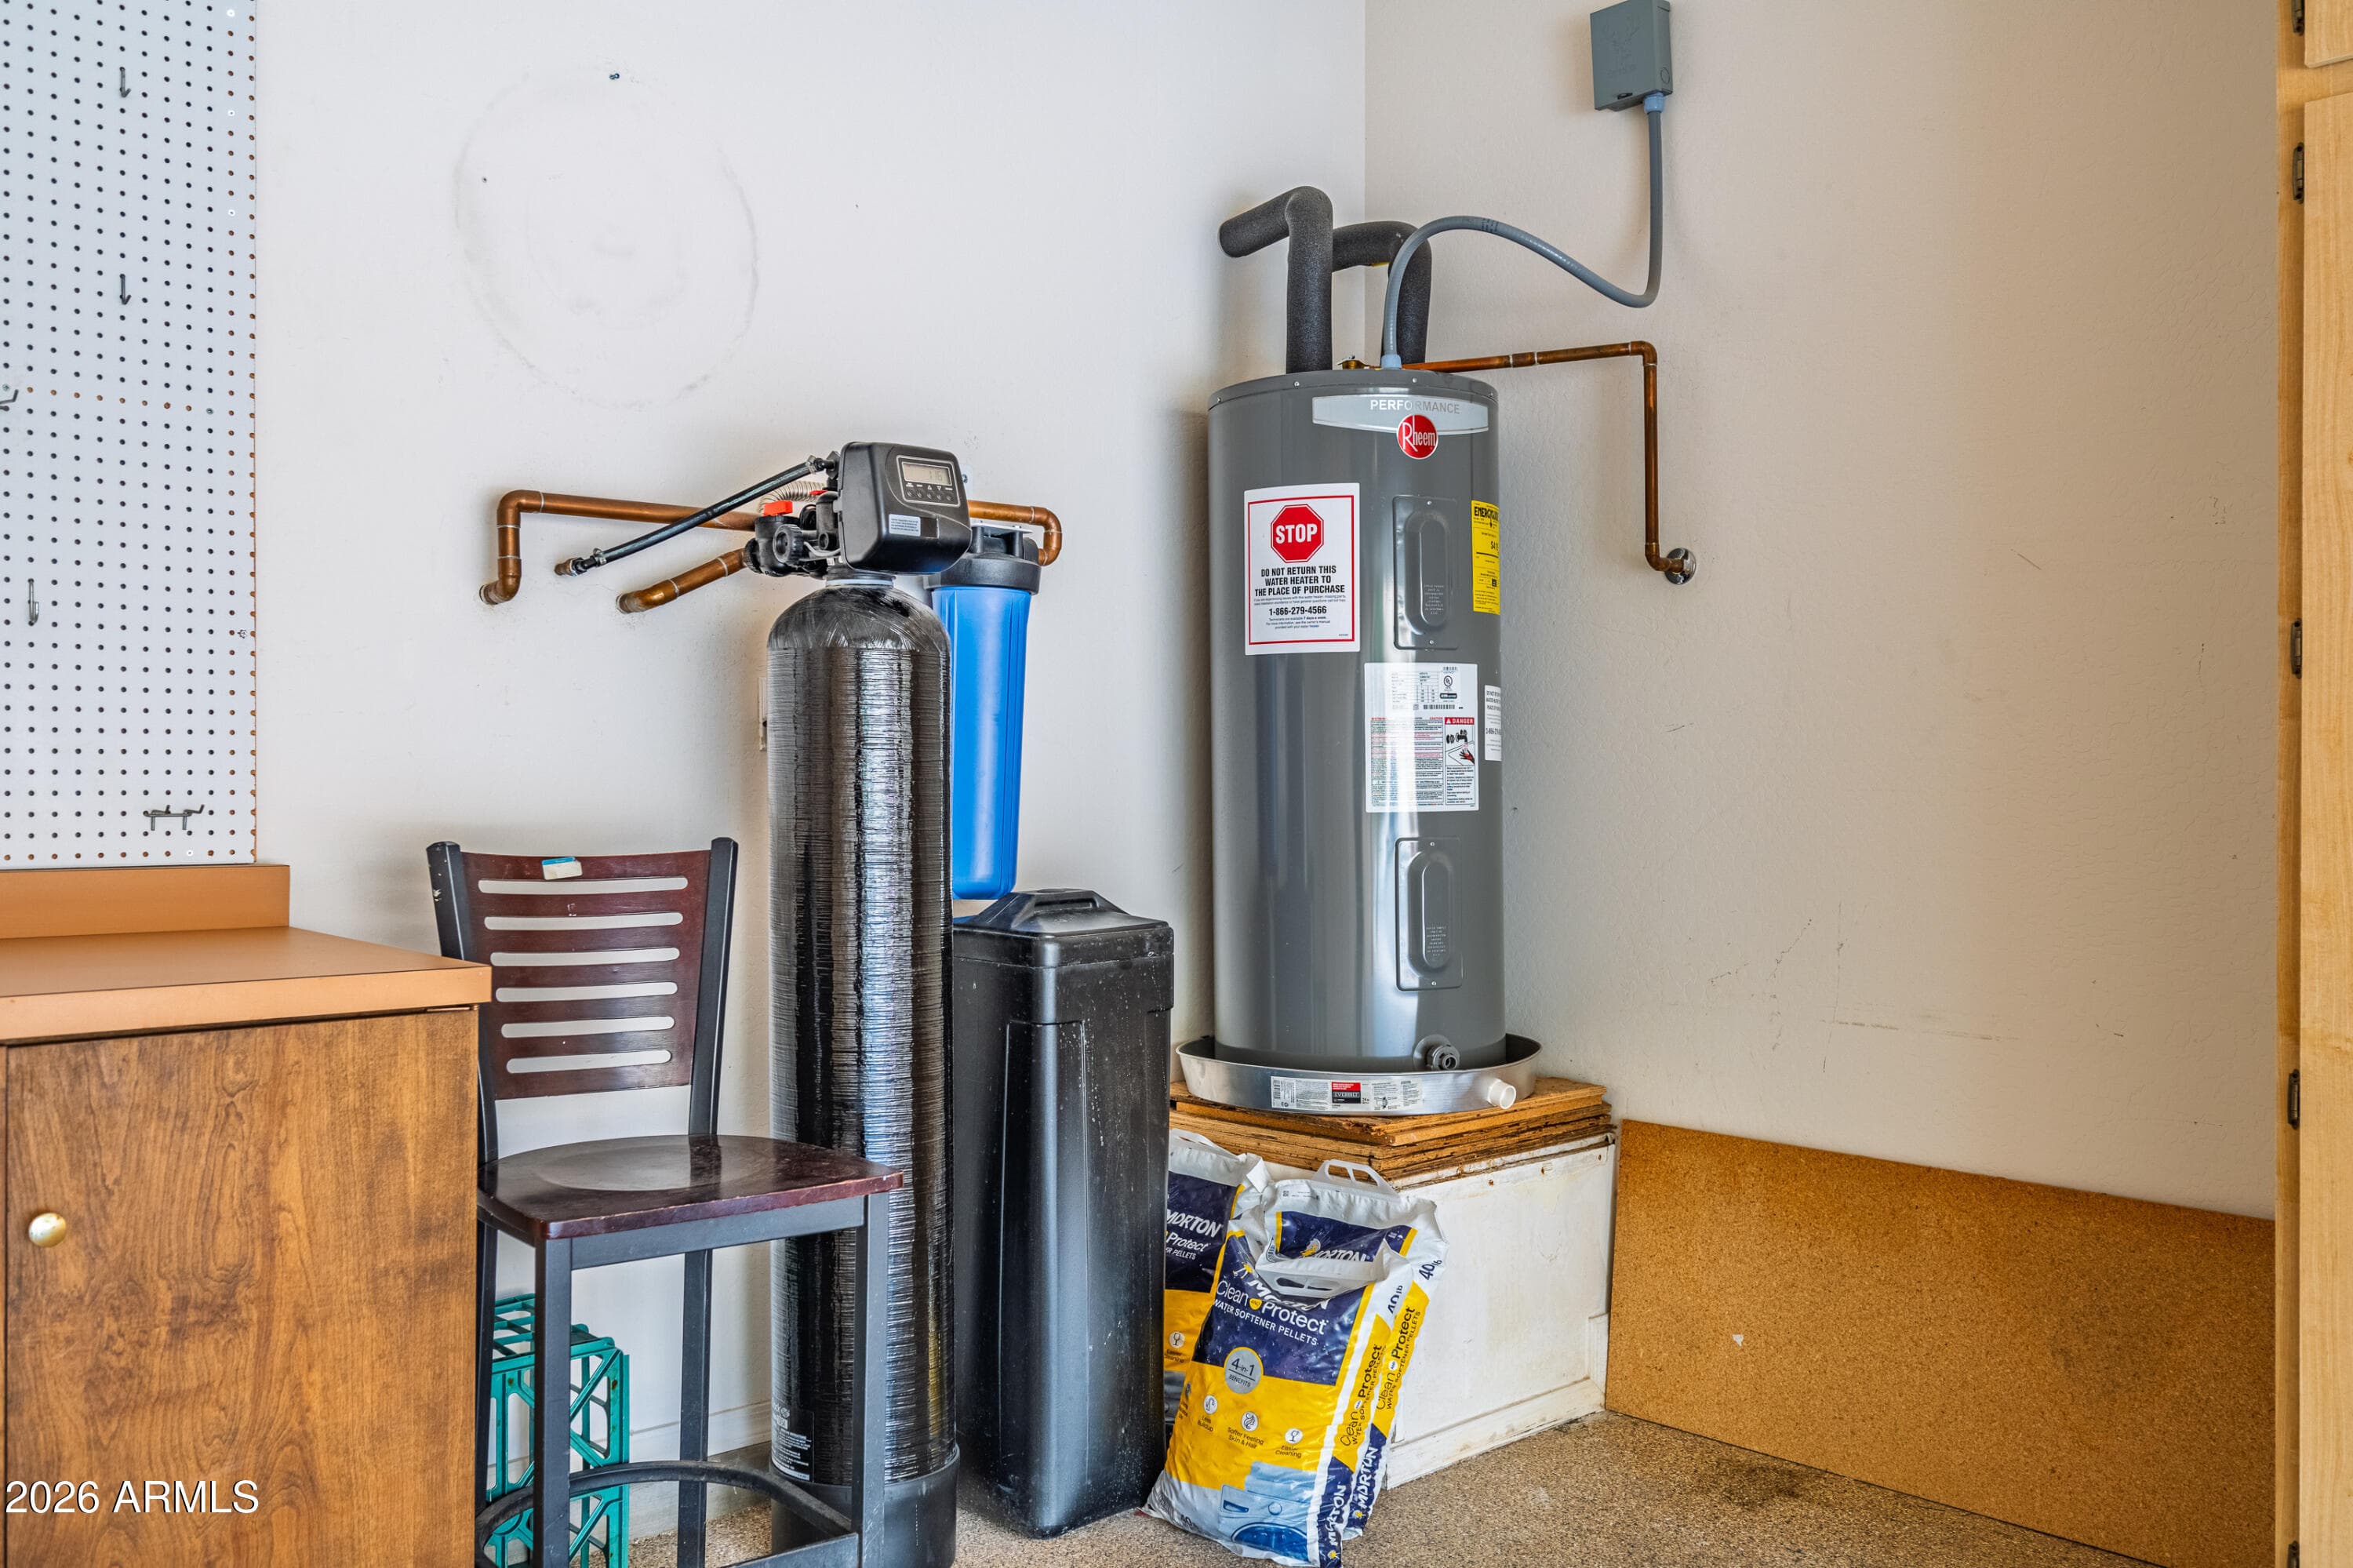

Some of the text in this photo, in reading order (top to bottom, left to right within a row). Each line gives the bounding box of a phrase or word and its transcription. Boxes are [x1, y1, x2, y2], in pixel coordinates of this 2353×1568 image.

[1370, 399, 1460, 414] PERFORMANCE
[1402, 415, 1436, 452] Rheem
[1275, 523, 1318, 544] STOP
[1261, 566, 1337, 577] DO NOT RETURN THIS
[1265, 575, 1331, 586] WATER HEATER TO
[1268, 587, 1289, 595] PLACE
[1292, 586, 1301, 595] OF
[1304, 585, 1345, 594] PURCHASE
[1269, 606, 1327, 616] 1-866-279-4566
[1166, 1231, 1209, 1252] Protect
[1172, 1250, 1197, 1260] PELLETS
[1217, 1280, 1249, 1306] Clean
[1261, 1301, 1328, 1334] Protect
[1213, 1299, 1318, 1345] WATER SOFTENER PELLETS
[1377, 1373, 1395, 1410] Clean
[1391, 1307, 1415, 1359] Protect
[1387, 1311, 1421, 1410] WATER SOFTENER PELLETS
[1228, 1374, 1251, 1388] BENEFITS
[1340, 1411, 1359, 1446] Clean
[1358, 1344, 1382, 1398] Protect
[1227, 1427, 1242, 1437] Softer
[1228, 1435, 1240, 1444] Skin
[1275, 1450, 1302, 1459] Cleaning
